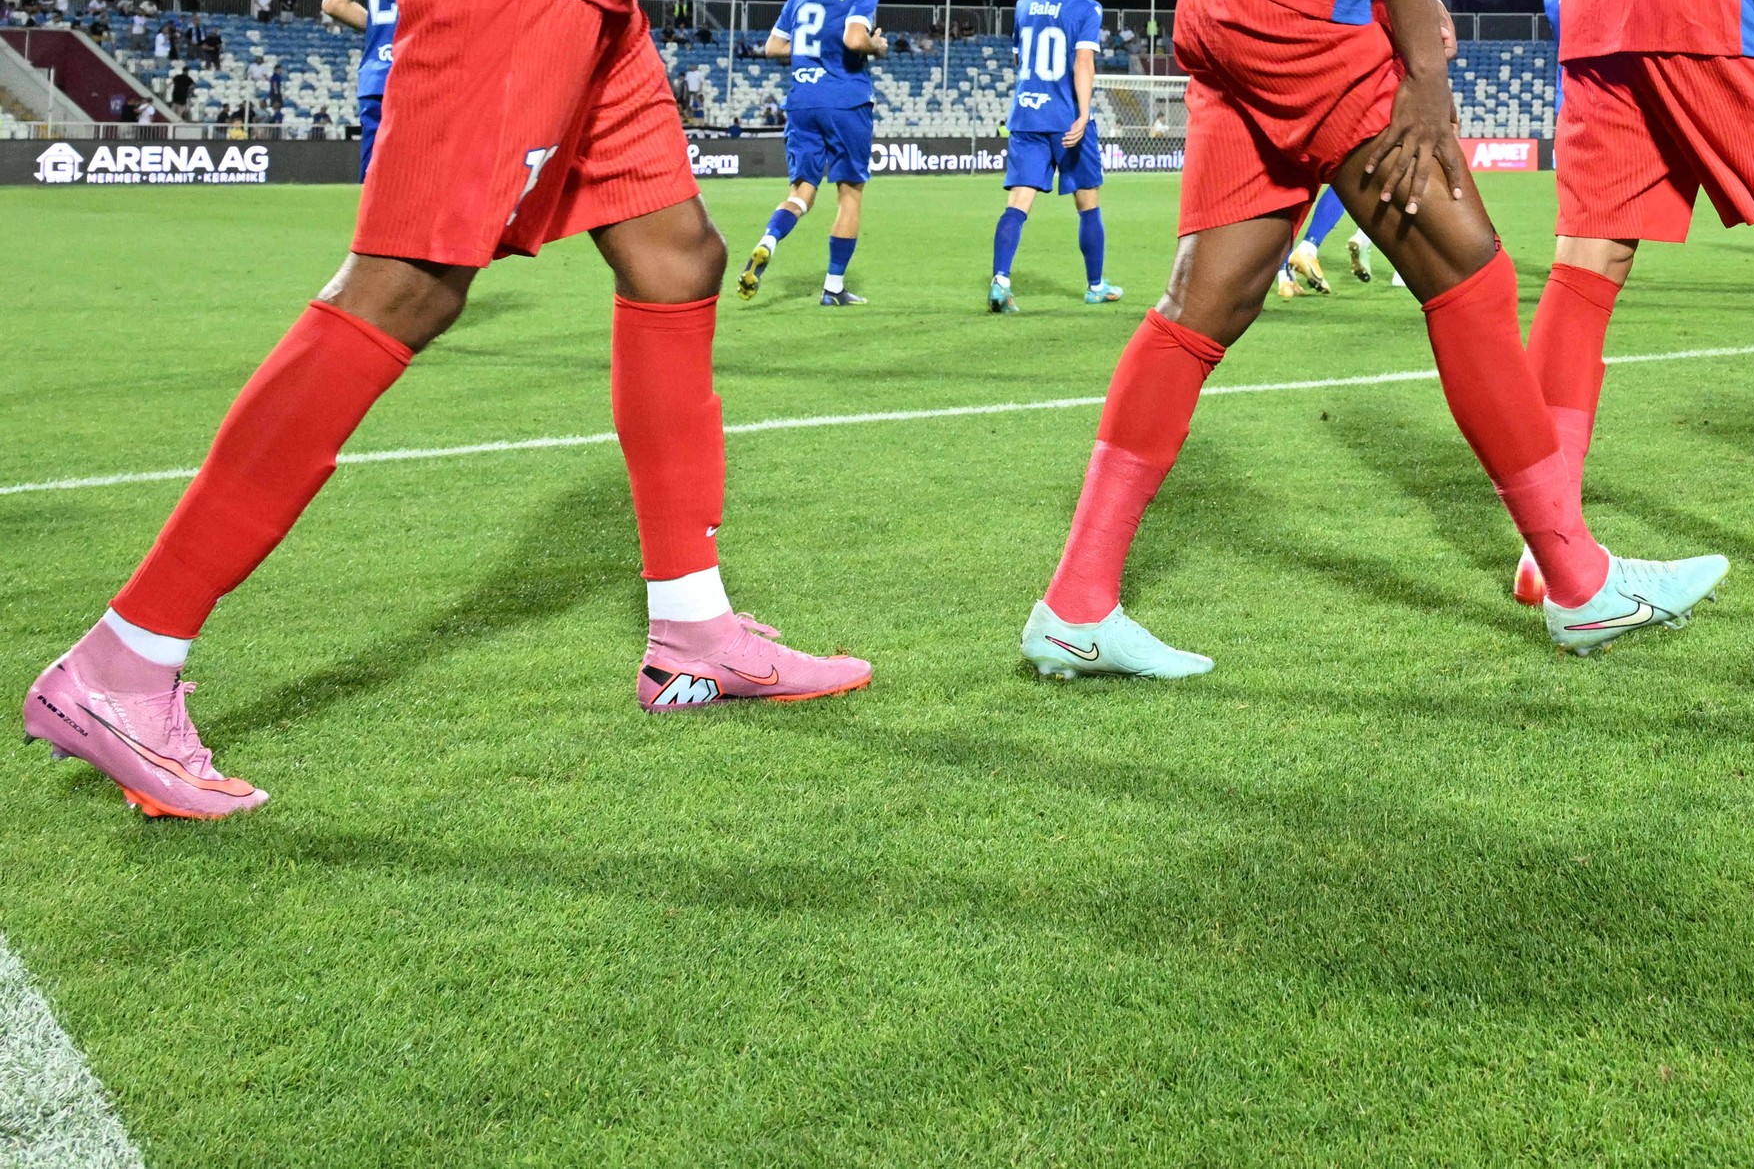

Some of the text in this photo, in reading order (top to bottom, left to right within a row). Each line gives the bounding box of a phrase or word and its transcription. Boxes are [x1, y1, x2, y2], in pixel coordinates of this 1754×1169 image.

[1028, 1, 1062, 19] Balaj
[793, 2, 827, 58] 2
[1018, 26, 1067, 82] 10
[86, 145, 269, 173] ARENA AG
[86, 172, 142, 184] MERMER
[148, 172, 195, 184] GRANIT
